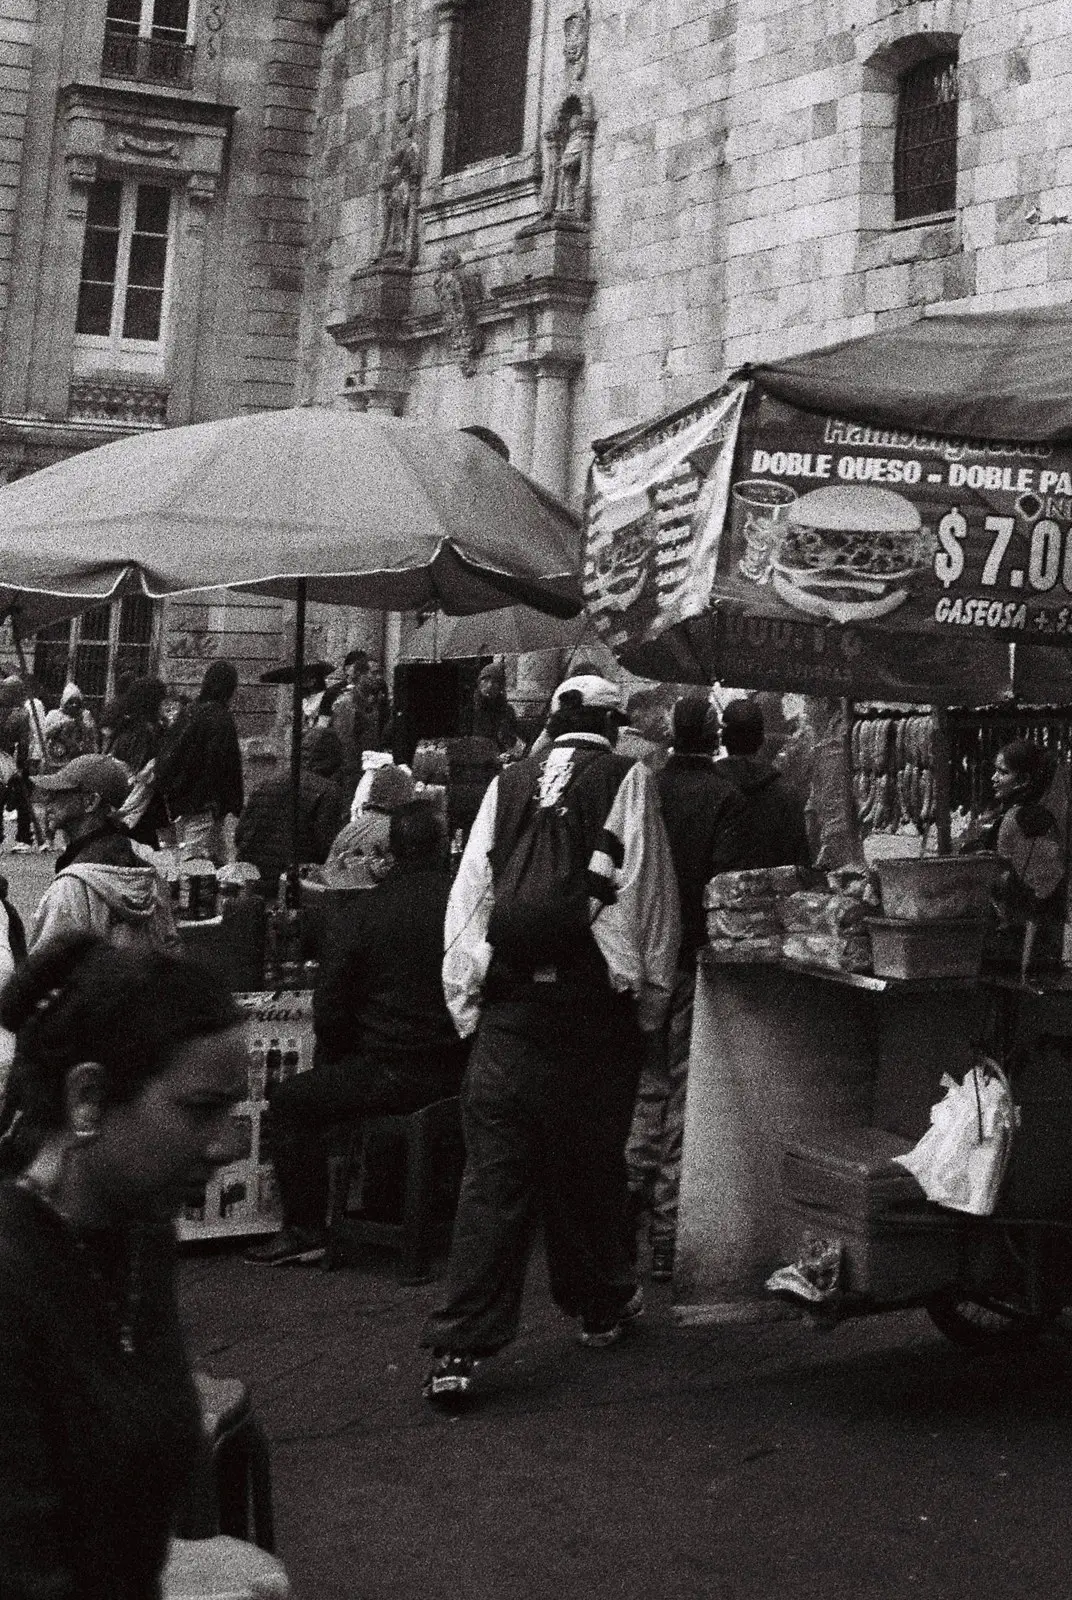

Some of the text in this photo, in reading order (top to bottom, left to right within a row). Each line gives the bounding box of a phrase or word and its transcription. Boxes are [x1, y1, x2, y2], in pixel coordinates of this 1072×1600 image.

[751, 450, 832, 478] DOBLE
[837, 456, 922, 485] QUESO
[949, 463, 1034, 493] DOBLE
[934, 597, 1028, 630] GASEOSA
